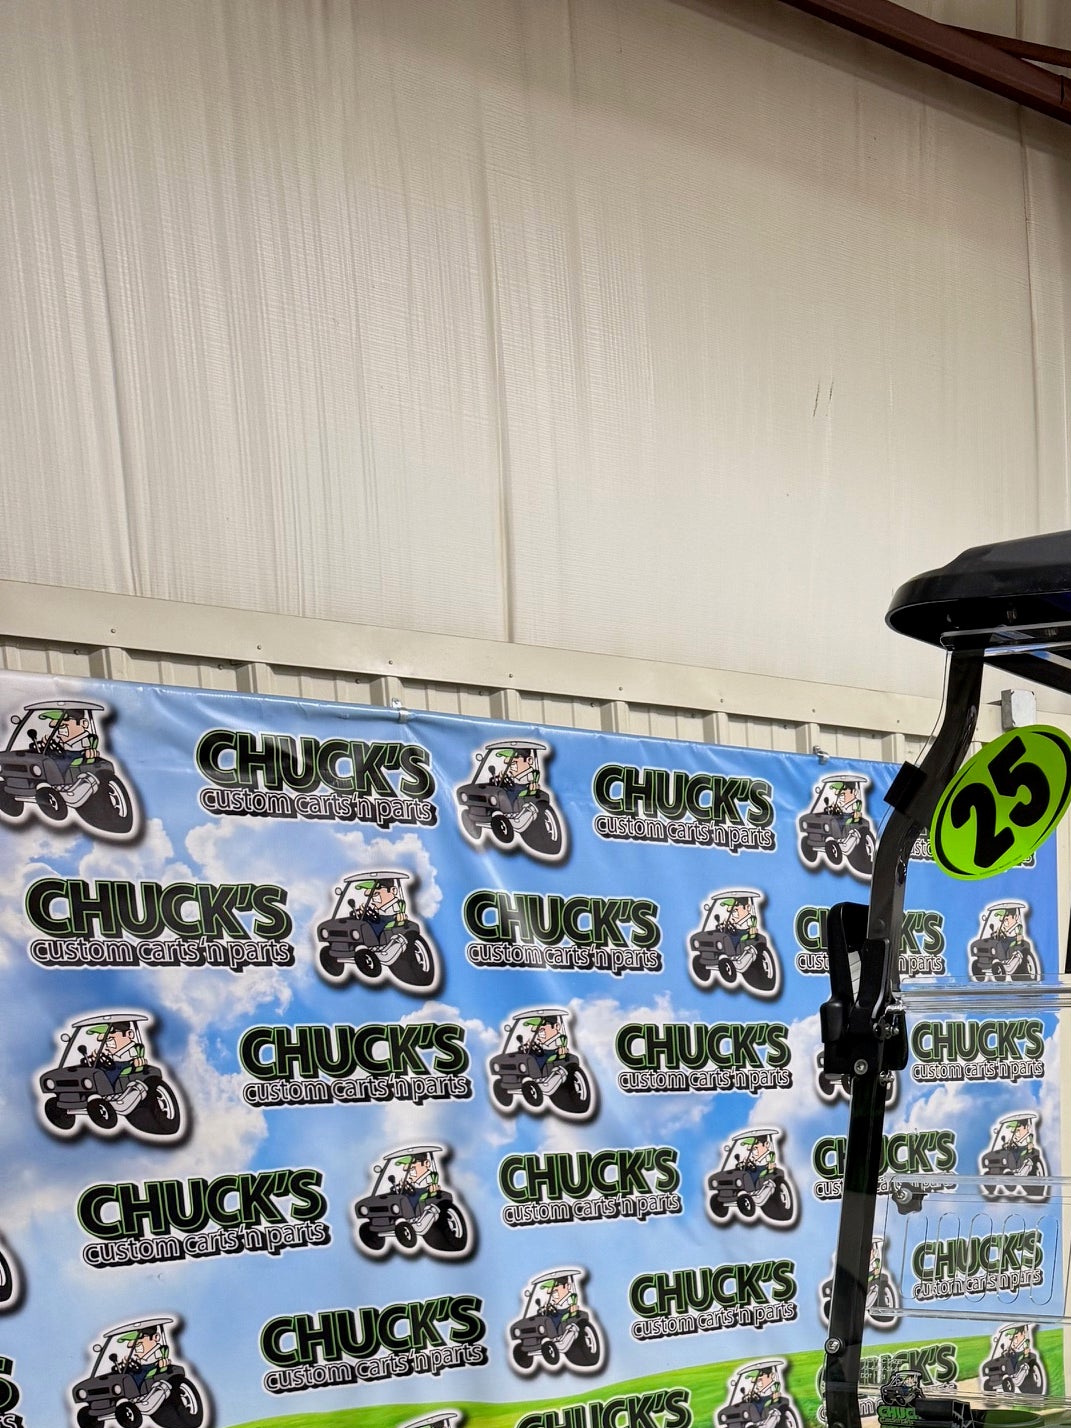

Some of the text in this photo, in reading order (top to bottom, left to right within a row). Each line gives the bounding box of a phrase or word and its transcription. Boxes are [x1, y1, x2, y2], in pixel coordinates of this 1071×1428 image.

[196, 729, 436, 800] CHUCK'S
[201, 788, 292, 815] custom
[376, 798, 434, 825] parts
[593, 765, 775, 827] CHUCK'S
[951, 735, 1050, 868] 25
[596, 816, 664, 839] custom
[728, 826, 773, 850] parts
[25, 877, 292, 940] CHUCK'S
[464, 890, 661, 948] CHUCK'S
[30, 938, 133, 963] custom
[227, 940, 290, 969] parts
[467, 943, 543, 964] custom
[611, 949, 659, 972] parts
[909, 955, 943, 976] parts
[239, 1023, 469, 1080] CHUCK'S
[616, 1023, 791, 1070] CHUCK'S
[911, 1019, 1044, 1062] CHUCK'S
[243, 1080, 328, 1104] custom
[412, 1076, 468, 1102] parts
[618, 1070, 686, 1090] custom
[748, 1069, 790, 1092] parts
[912, 1062, 962, 1080] custom
[499, 1148, 680, 1204] CHUCK'S
[77, 1169, 327, 1240] CHUCK'S
[503, 1200, 570, 1224] custom
[636, 1193, 680, 1219] parts
[83, 1236, 180, 1266] custom
[265, 1221, 325, 1253] parts
[629, 1260, 797, 1318] CHUCK'S
[260, 1295, 486, 1368] CHUCK'S
[632, 1315, 695, 1339] custom
[753, 1301, 795, 1326] parts
[264, 1362, 351, 1392] custom
[430, 1343, 484, 1375] parts
